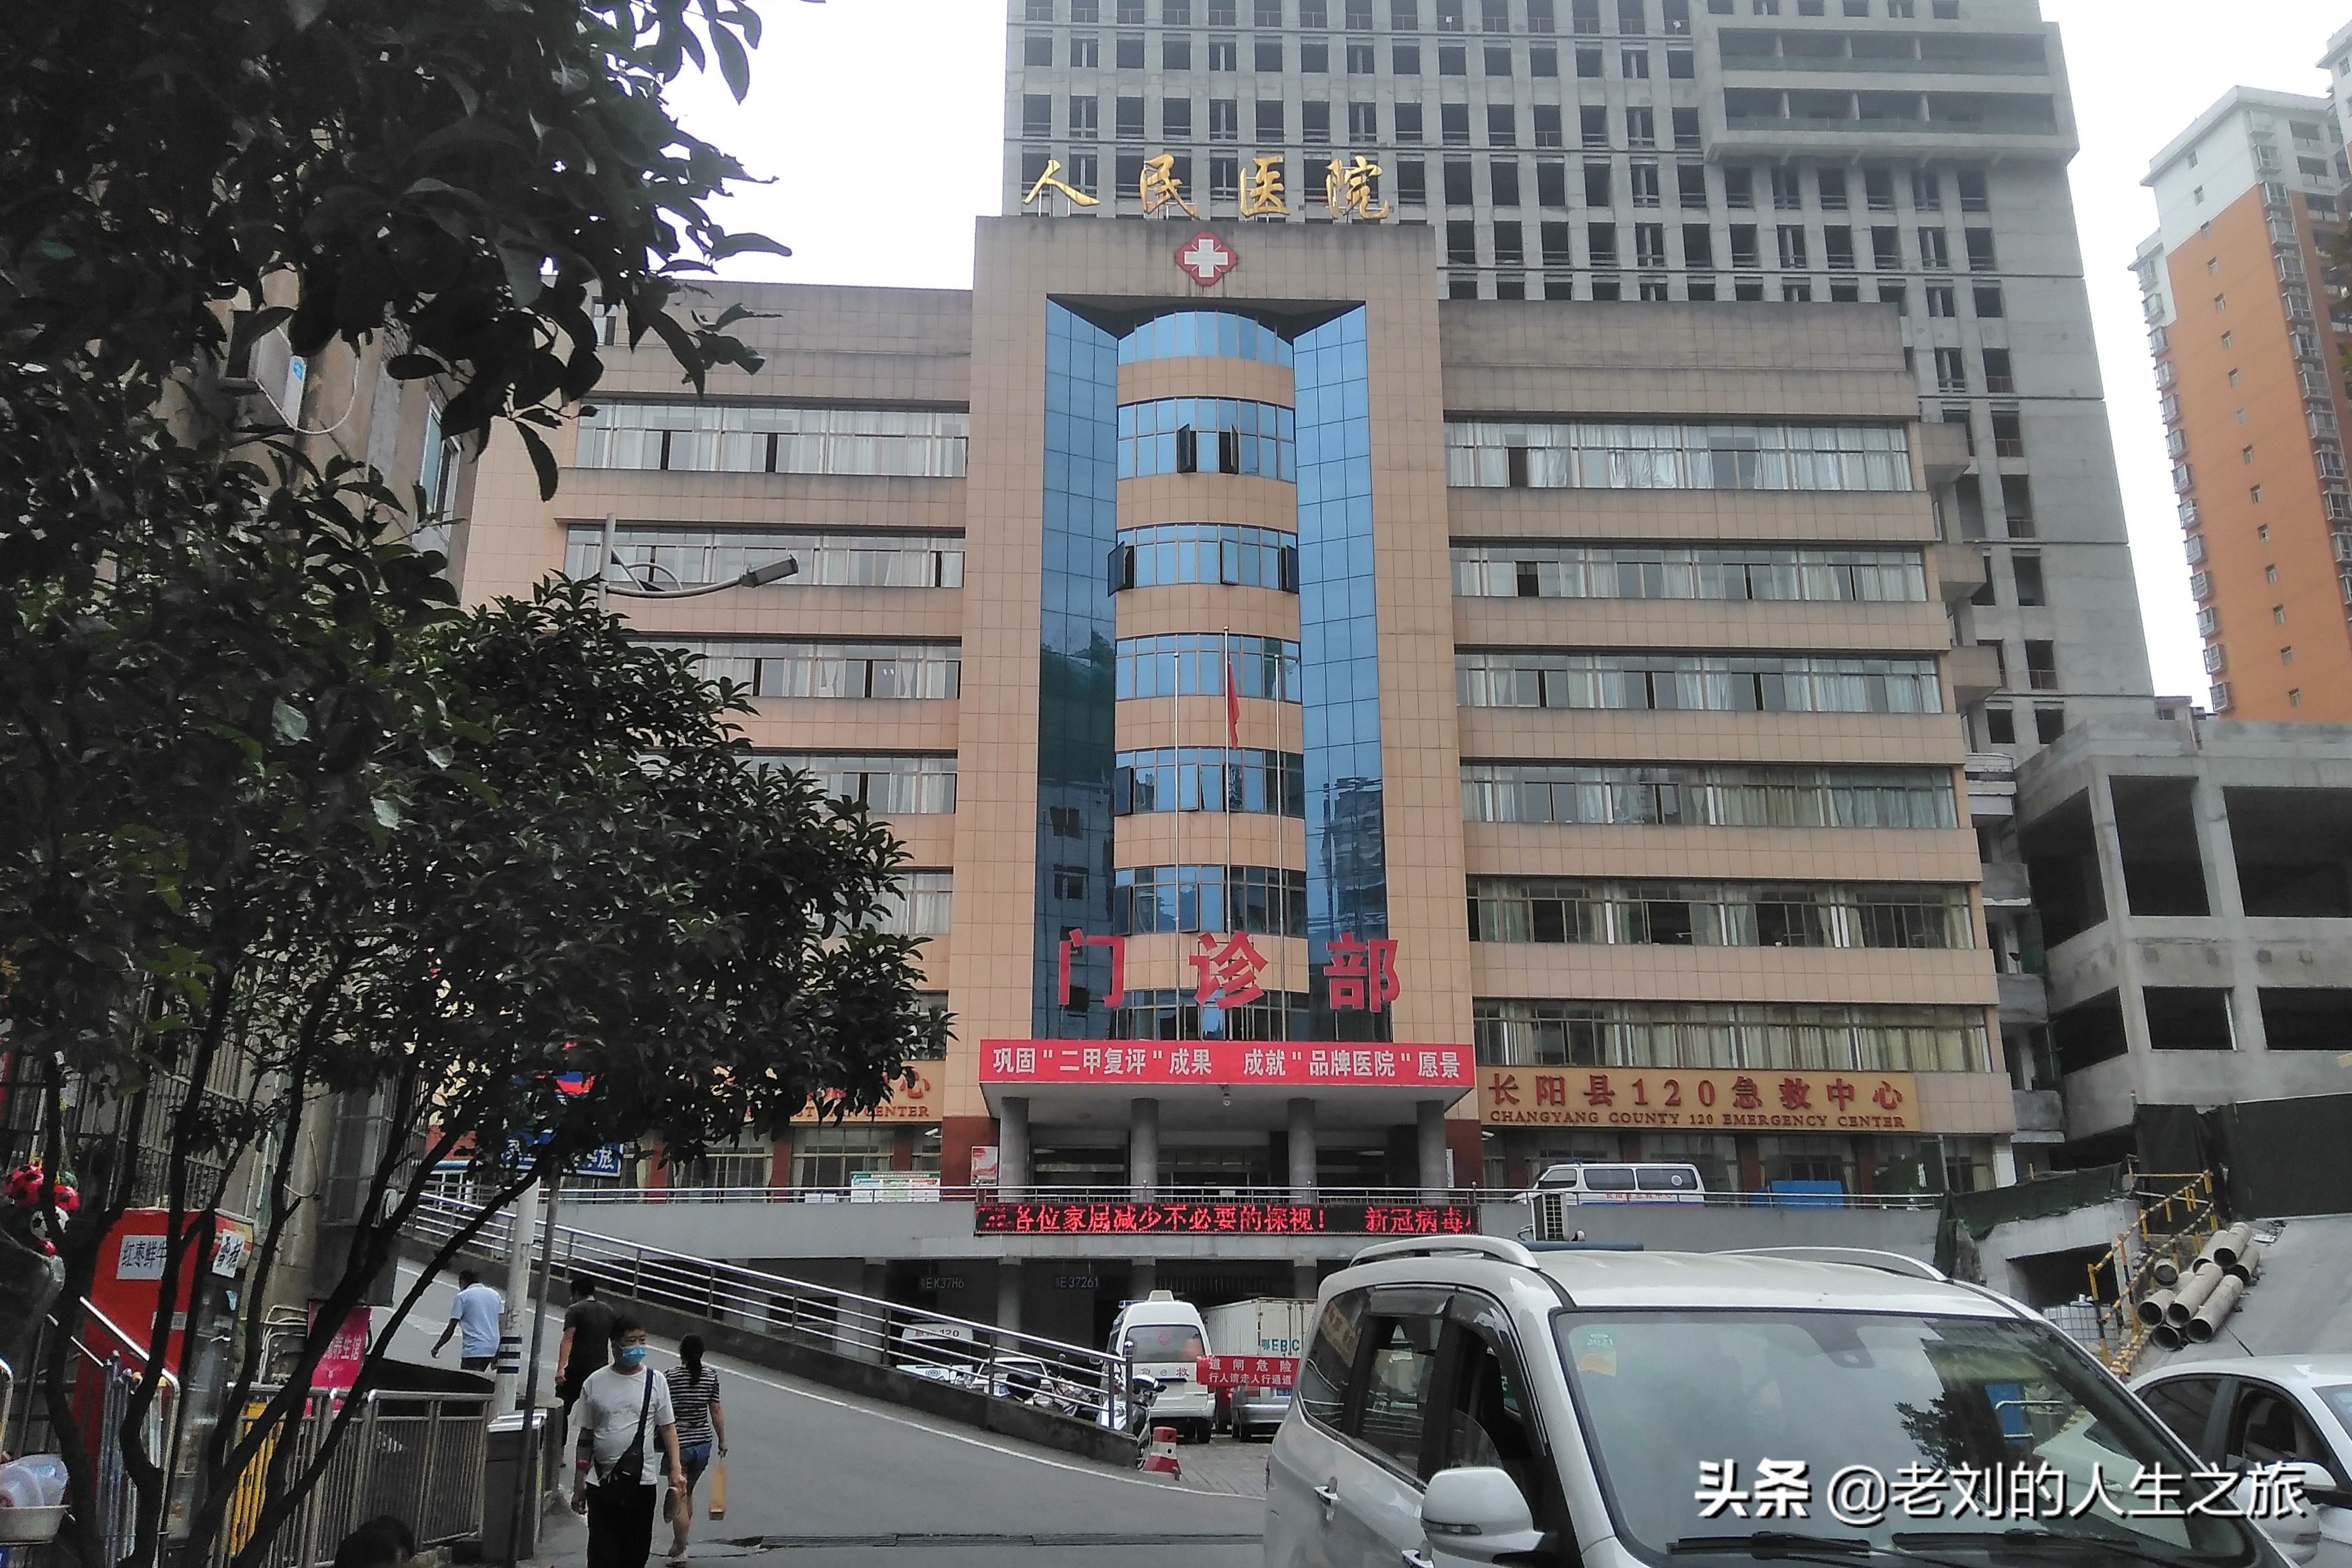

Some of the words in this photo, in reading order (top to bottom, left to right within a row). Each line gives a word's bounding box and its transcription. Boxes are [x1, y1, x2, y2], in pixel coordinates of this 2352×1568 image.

[1023, 154, 1390, 220] 人民医院
[1059, 929, 1401, 1013] 门诊部
[1488, 1073, 1903, 1111] 长阳县120急救中心
[1490, 1111, 1599, 1123] CHANGYANG
[1608, 1112, 1680, 1124] COUNTY
[1690, 1114, 1713, 1125] 120
[1723, 1115, 1827, 1126] EMERGENCY
[1838, 1117, 1905, 1127] CENTER
[1365, 1206, 1471, 1233] 新冠病毒
[1208, 1372, 1292, 1386] 行人请走人行通道
